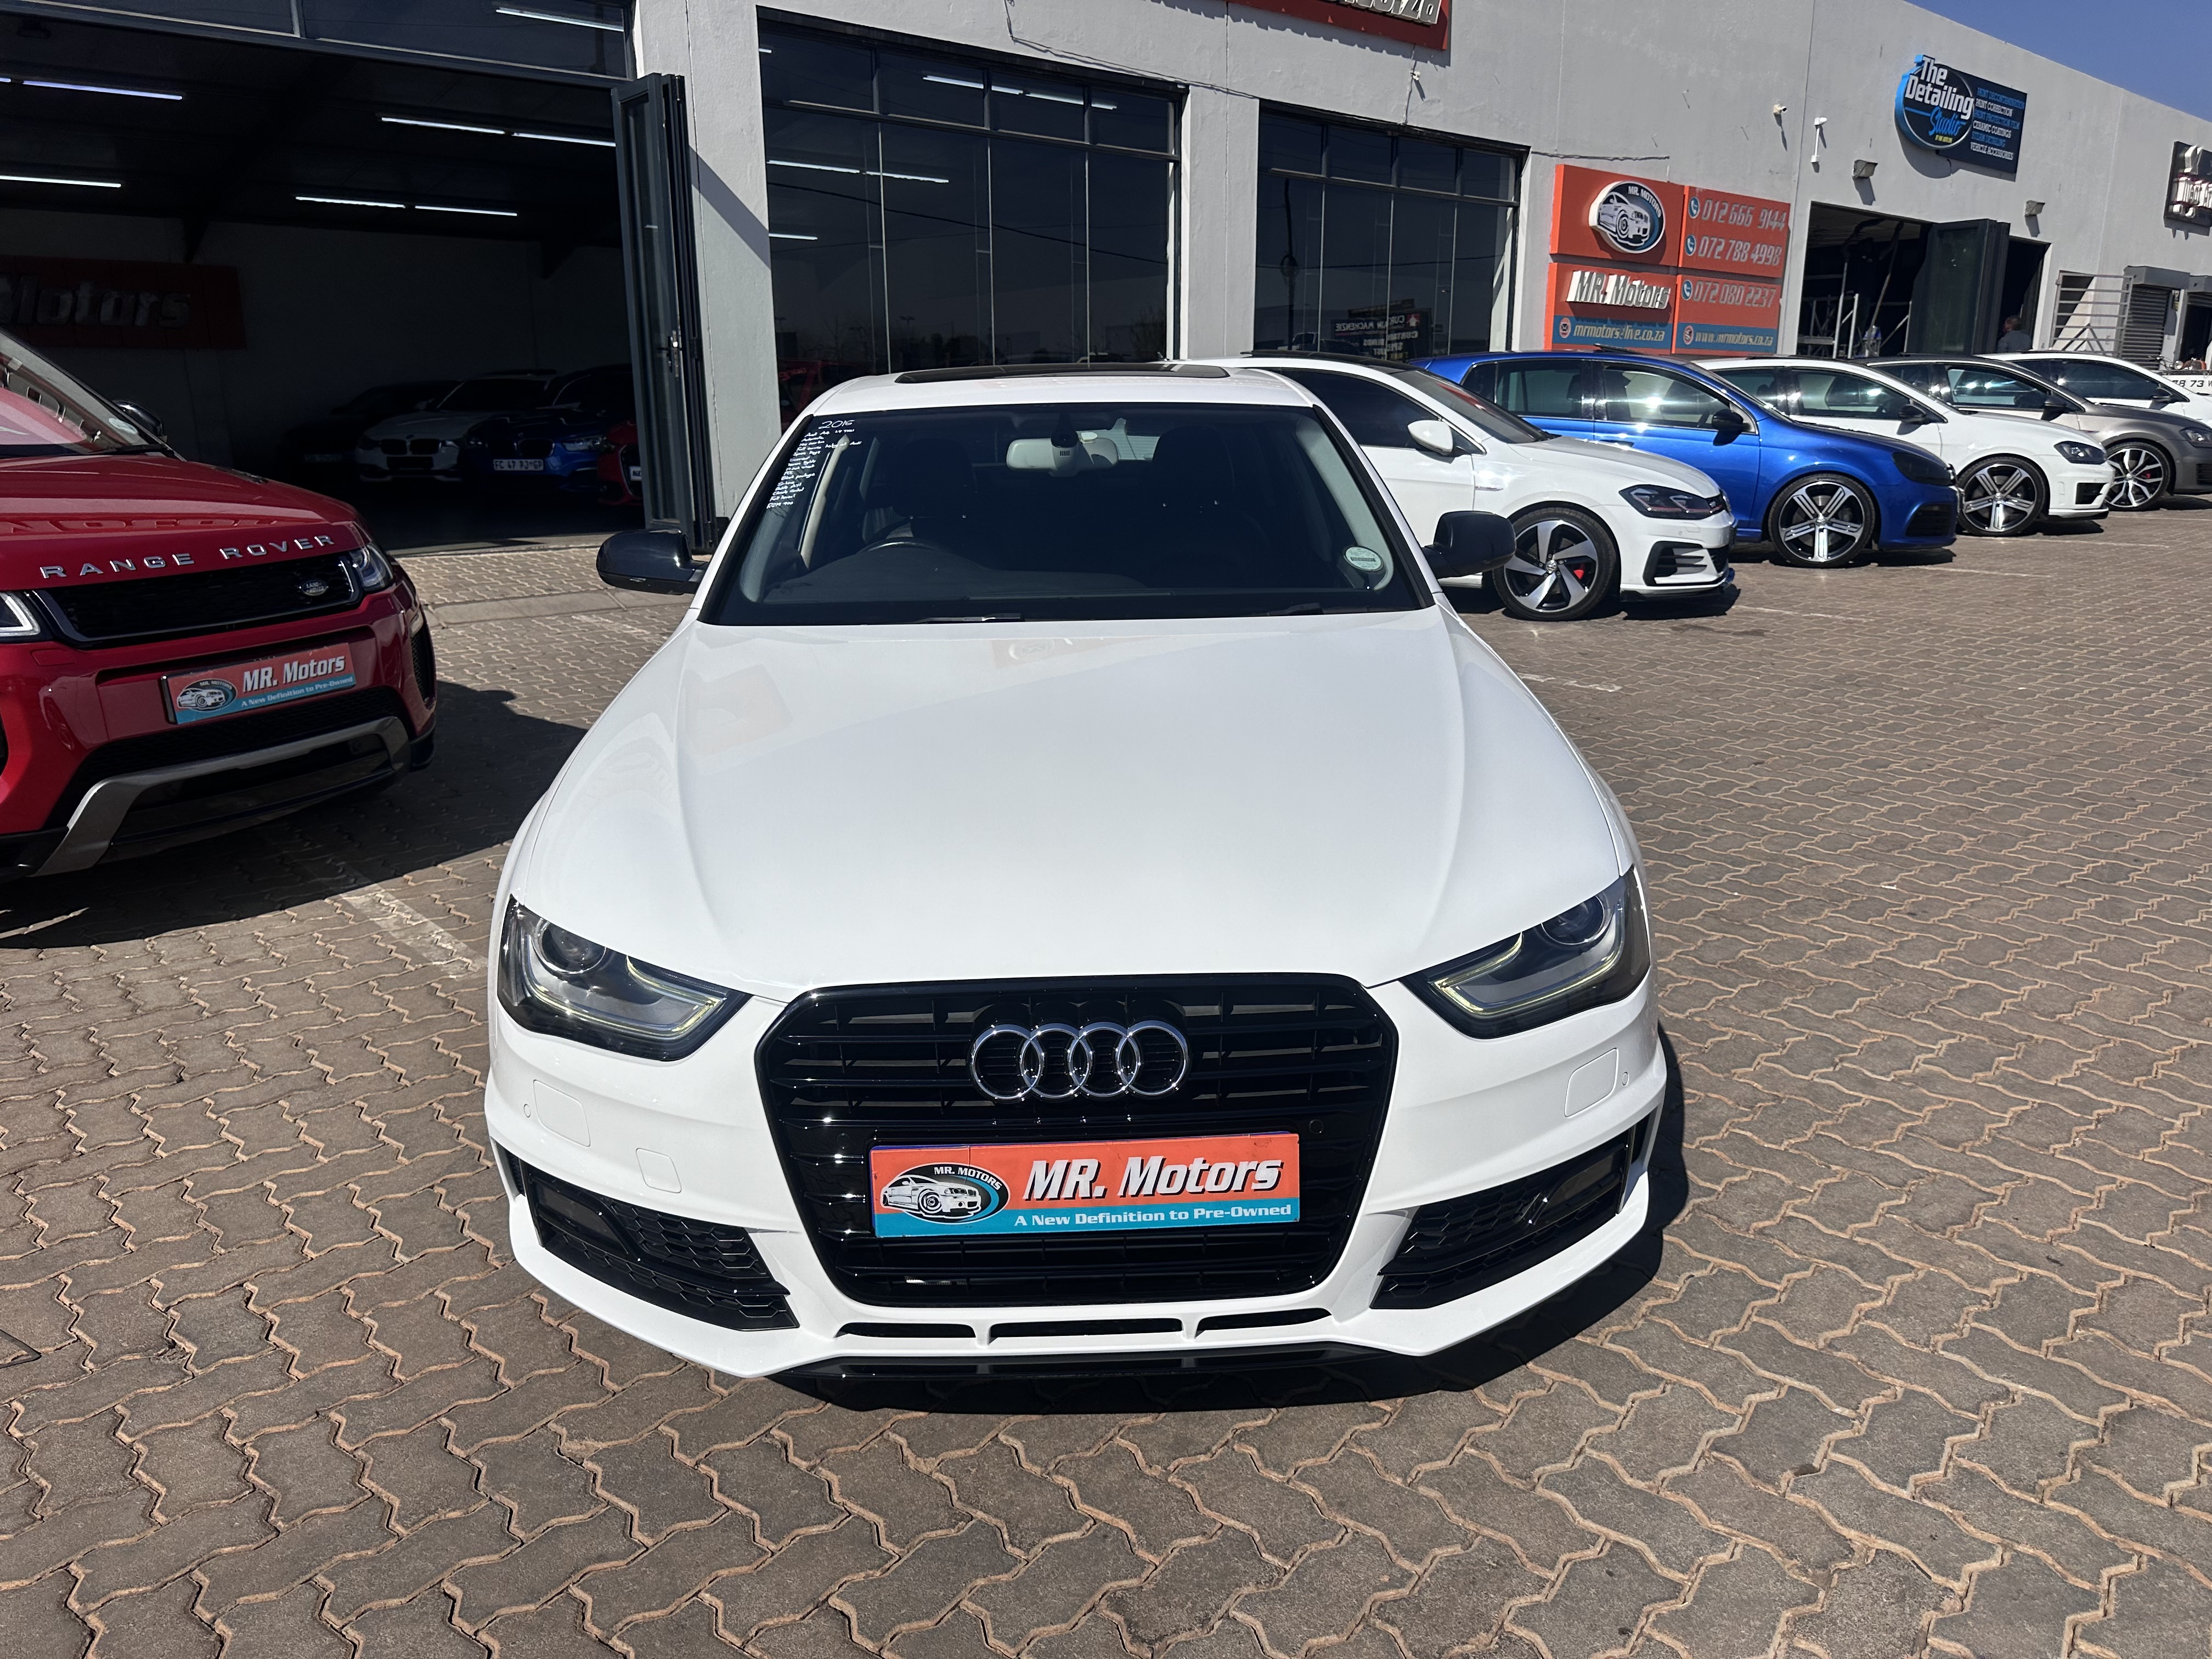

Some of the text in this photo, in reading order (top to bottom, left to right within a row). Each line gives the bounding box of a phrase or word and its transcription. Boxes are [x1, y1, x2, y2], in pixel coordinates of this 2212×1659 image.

[1920, 55, 1948, 86] The
[1905, 75, 1974, 120] Detailing
[1987, 102, 2013, 117] CORRECTION
[1928, 106, 1966, 136] Studio
[1973, 120, 2012, 138] CERAMIC COATINGS
[1971, 142, 2014, 160] VEHICLE ACCESSORIES
[1628, 186, 1662, 218] MR. MOTORS
[1702, 199, 1787, 232] 012 666 9144
[1698, 235, 1782, 266] 072 788 4998
[1567, 270, 1671, 309] MR. Motors
[1694, 281, 1776, 307] 072 080 2237
[1695, 332, 1774, 346] www.mrmotors.co.za
[818, 420, 855, 430] 2016
[40, 535, 335, 579] RANGE ROVER
[211, 680, 233, 690] MOTORS
[242, 655, 346, 693] MR. Motors
[249, 697, 266, 706] New
[267, 687, 304, 701] Definition
[315, 676, 353, 691] Pre-Owned
[934, 1166, 1002, 1190] MR. MOTORS
[1022, 1155, 1284, 1201] MR. Motors
[1014, 1204, 1291, 1226] A New Definition to Pre-Owned
